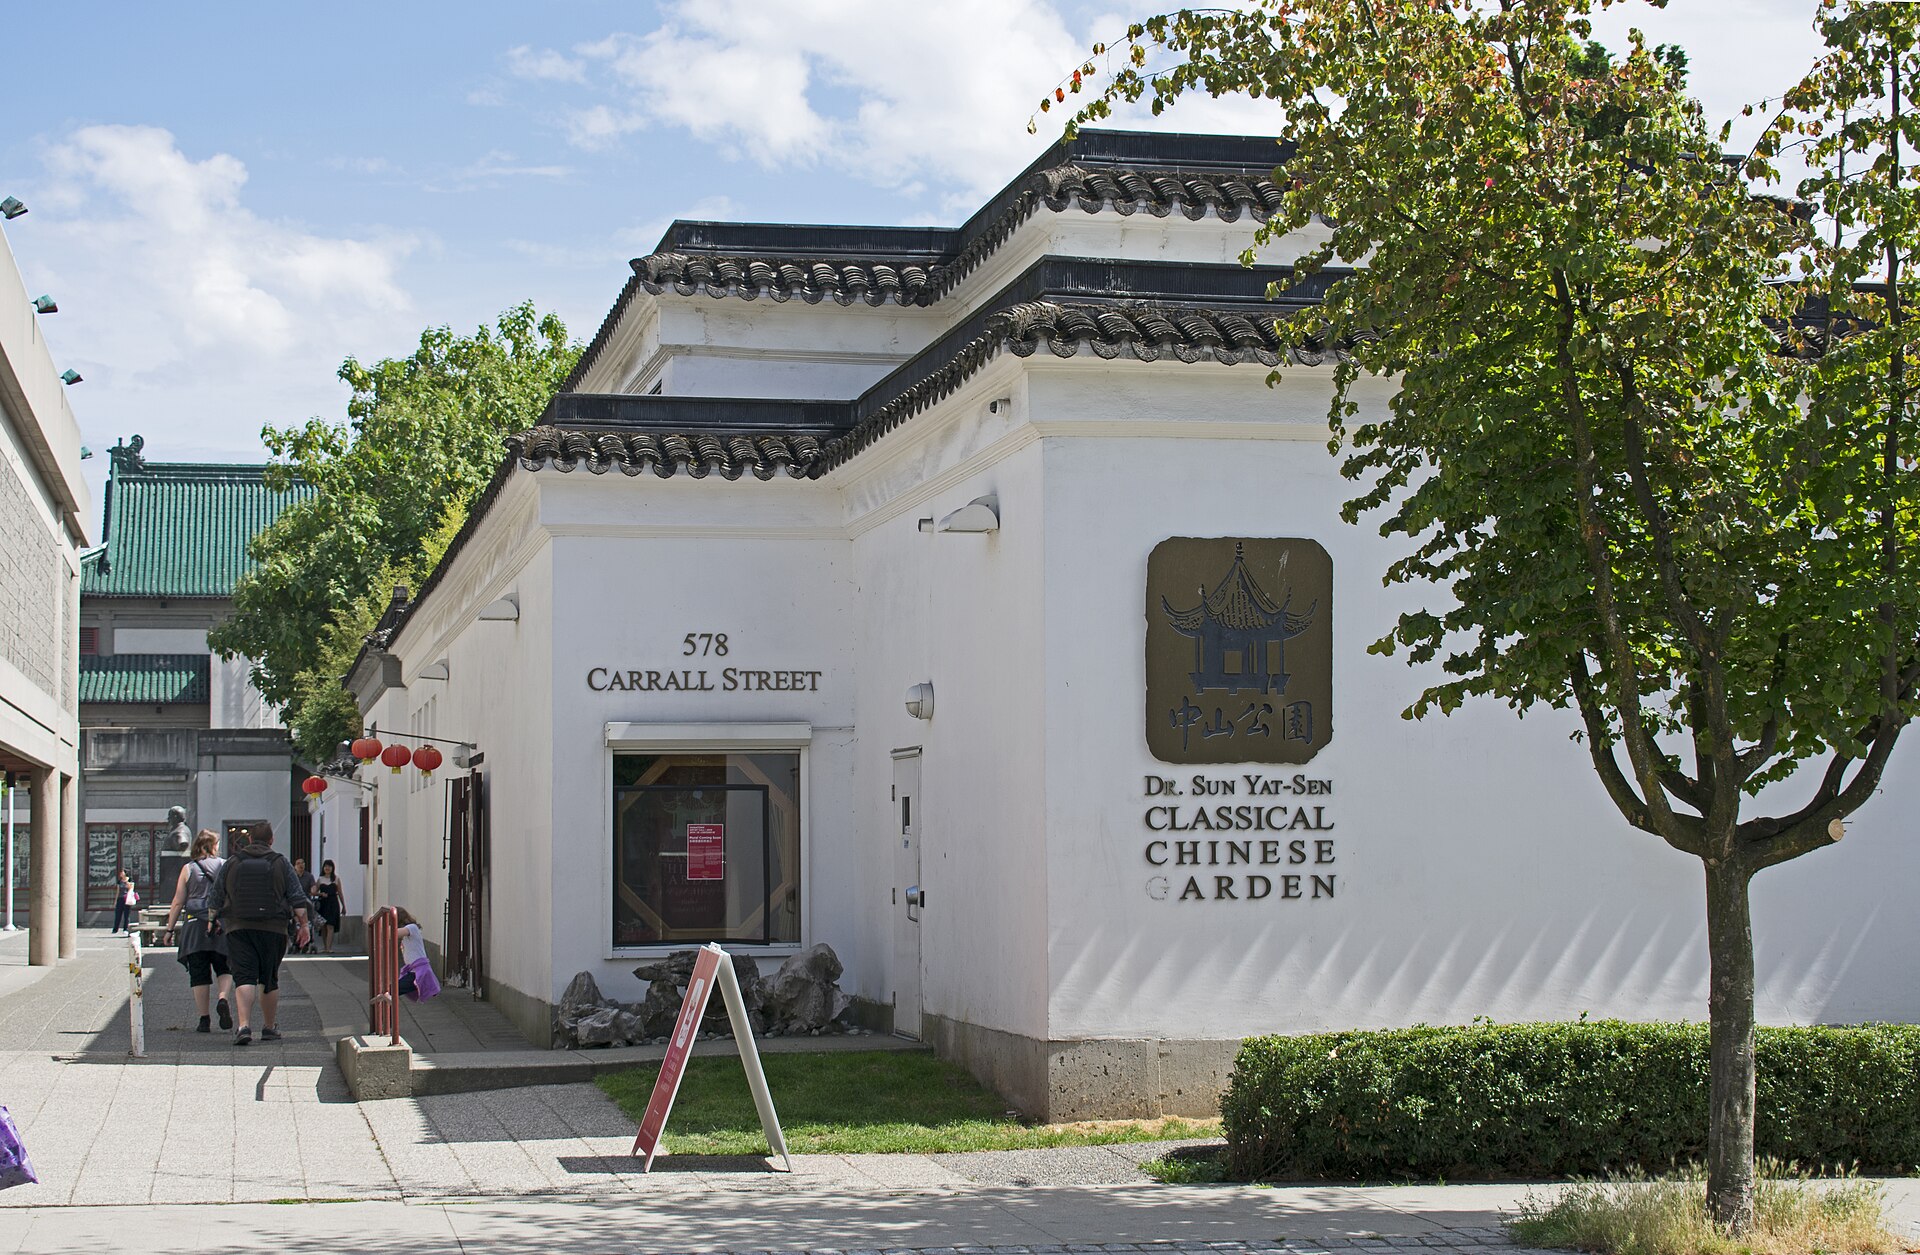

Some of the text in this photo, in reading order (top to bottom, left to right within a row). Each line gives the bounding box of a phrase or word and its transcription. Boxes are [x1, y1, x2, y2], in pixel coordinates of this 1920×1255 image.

[683, 633, 729, 657] 578
[587, 667, 822, 692] CARRALL STREET
[1169, 696, 1313, 752] 中山公園
[1144, 774, 1333, 796] DR. SUN YAT-SEN
[1145, 806, 1335, 831] CLASSICAL
[1145, 840, 1336, 866] CHINESE
